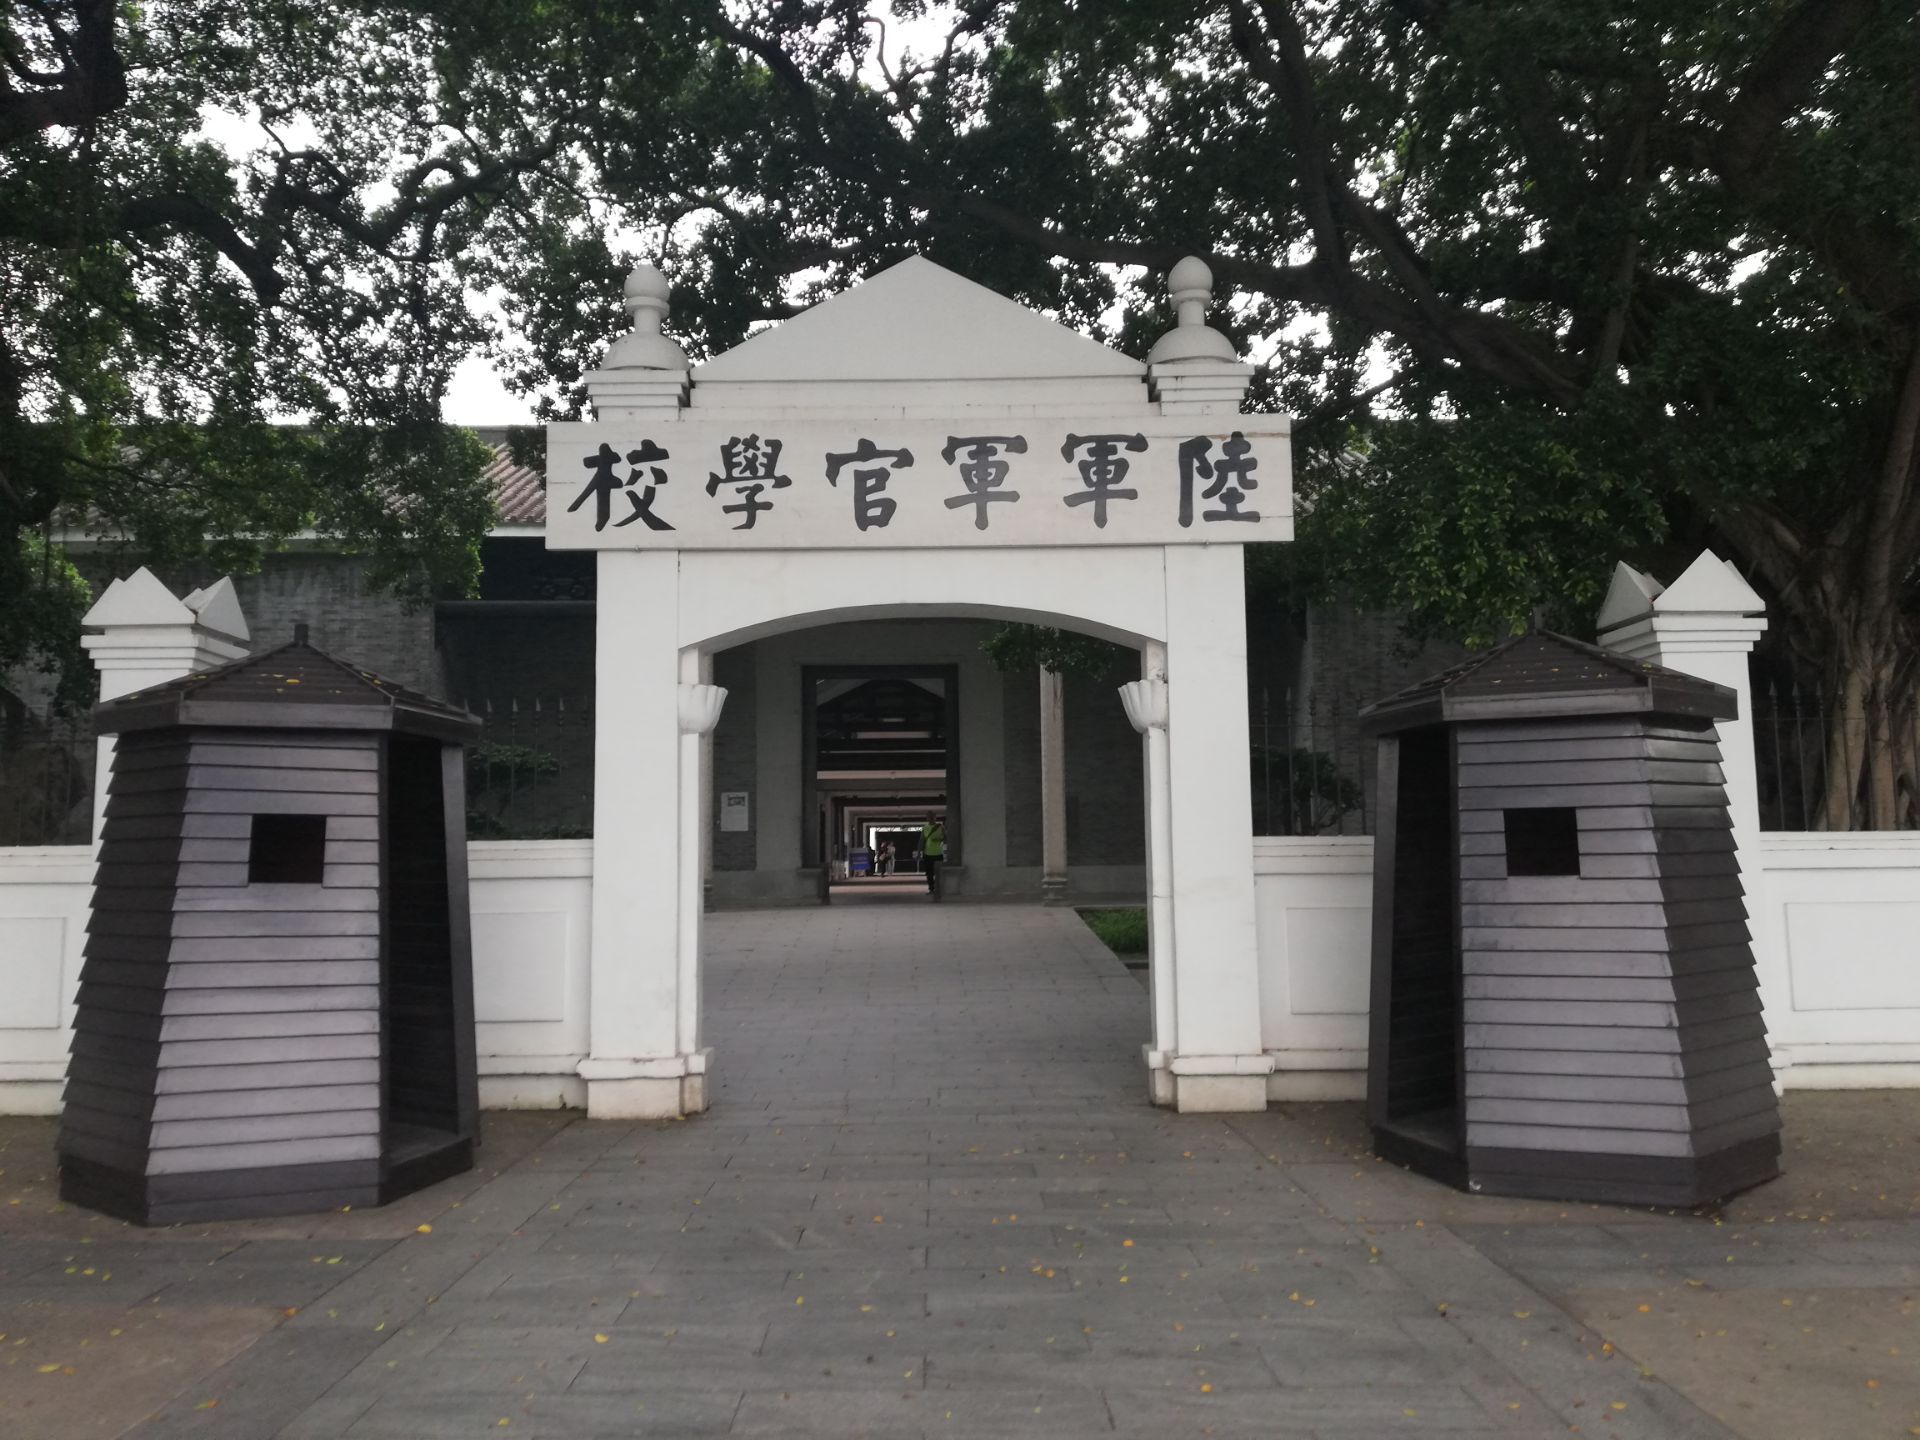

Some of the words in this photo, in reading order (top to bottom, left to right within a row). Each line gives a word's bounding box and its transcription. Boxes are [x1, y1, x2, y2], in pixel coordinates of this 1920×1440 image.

[567, 430, 1261, 532] 陸軍軍官學校
